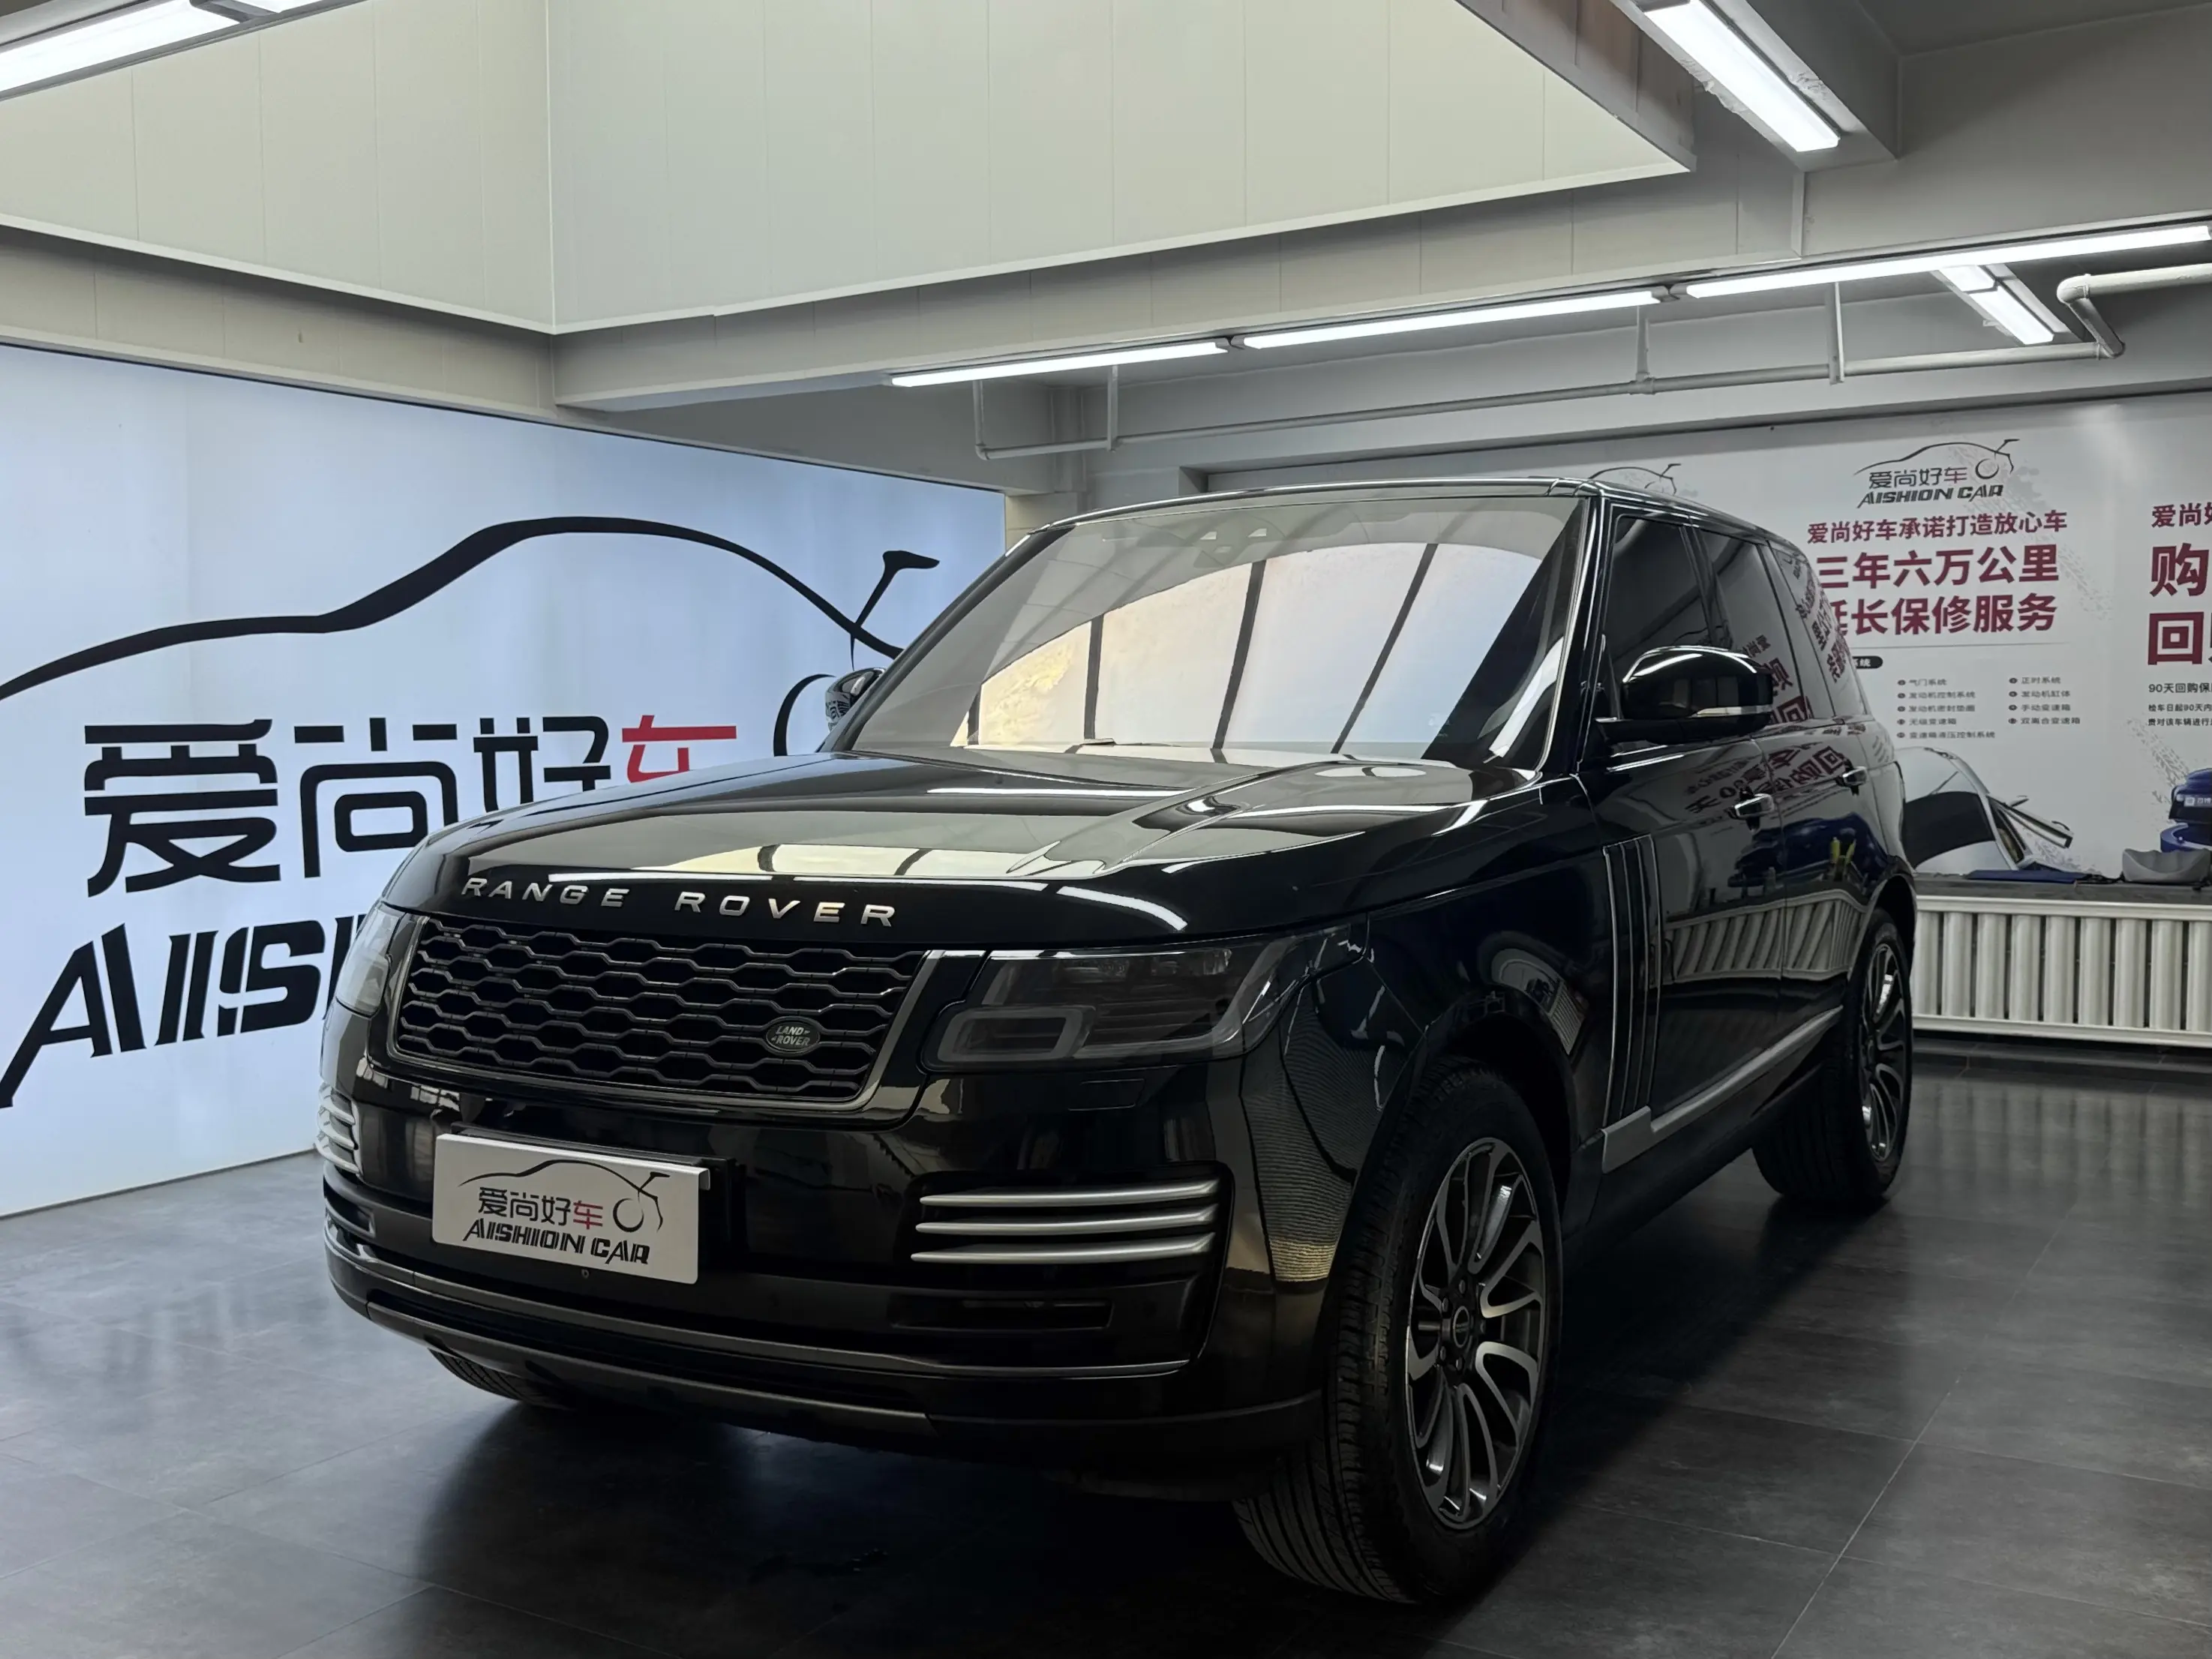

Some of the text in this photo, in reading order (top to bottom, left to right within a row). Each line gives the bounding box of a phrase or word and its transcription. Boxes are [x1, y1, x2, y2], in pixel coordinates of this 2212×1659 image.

[1868, 467, 1968, 489] 爱尚好车
[1856, 484, 2003, 508] AISHION CAR
[1807, 509, 2067, 544] 爱尚好车承诺打造放心车
[1816, 544, 2060, 590] 三年六万公里
[2149, 542, 2210, 597] 购
[2148, 682, 2212, 693] 90天回购保
[461, 877, 896, 927] RANGE ROVER
[776, 1025, 804, 1035] LAND
[776, 1035, 810, 1046] ROVER
[478, 1186, 604, 1230] 爱尚好车
[463, 1218, 650, 1264] AISHION CAR
